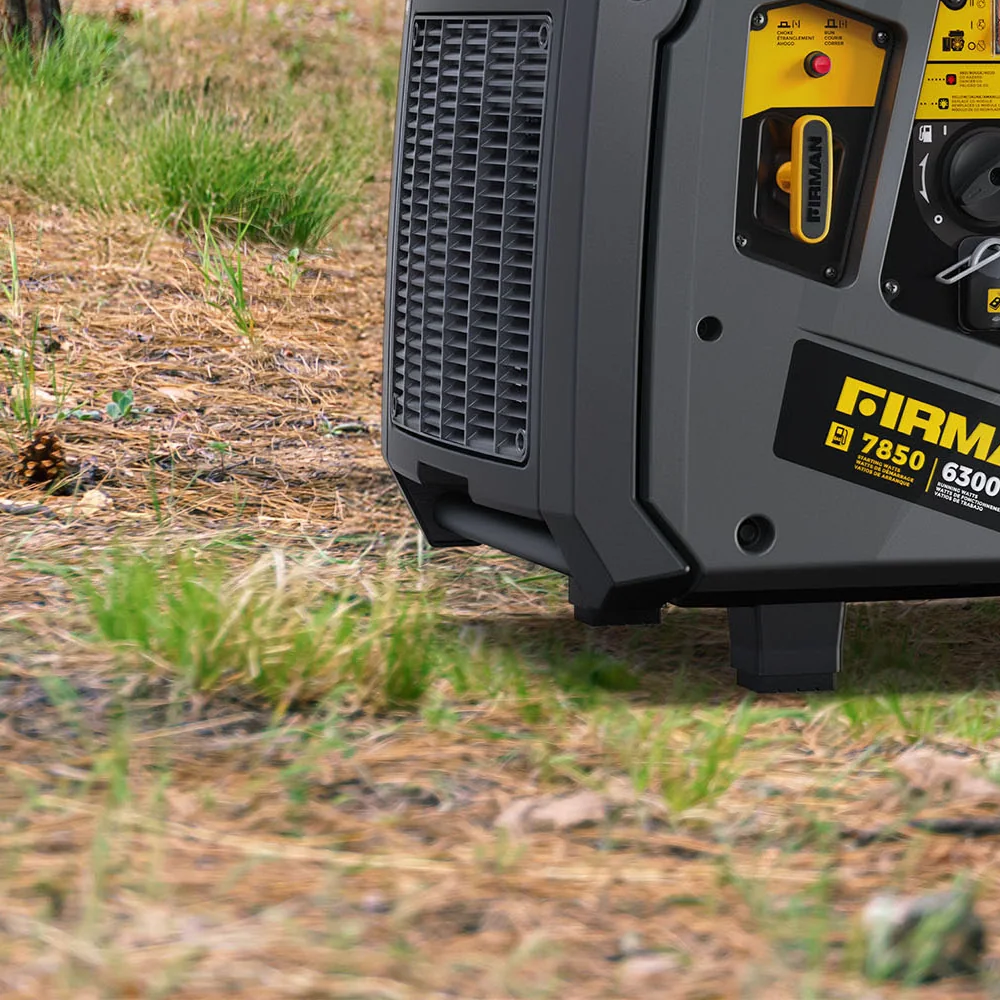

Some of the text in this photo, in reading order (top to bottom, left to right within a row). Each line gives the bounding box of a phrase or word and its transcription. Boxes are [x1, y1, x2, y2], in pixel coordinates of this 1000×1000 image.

[806, 136, 822, 223] FIRMAN
[861, 432, 926, 471] 7850
[856, 459, 873, 469] WATTS
[857, 455, 901, 473] STARTING WATTS
[854, 464, 873, 475] VATIOS
[881, 473, 910, 488] ARRANQUE
[941, 461, 1000, 497] 6300
[935, 486, 953, 495] WATTS
[937, 481, 979, 499] RUNNING WATTS
[934, 491, 952, 501] VATIOS
[960, 500, 984, 512] TRABAJO
